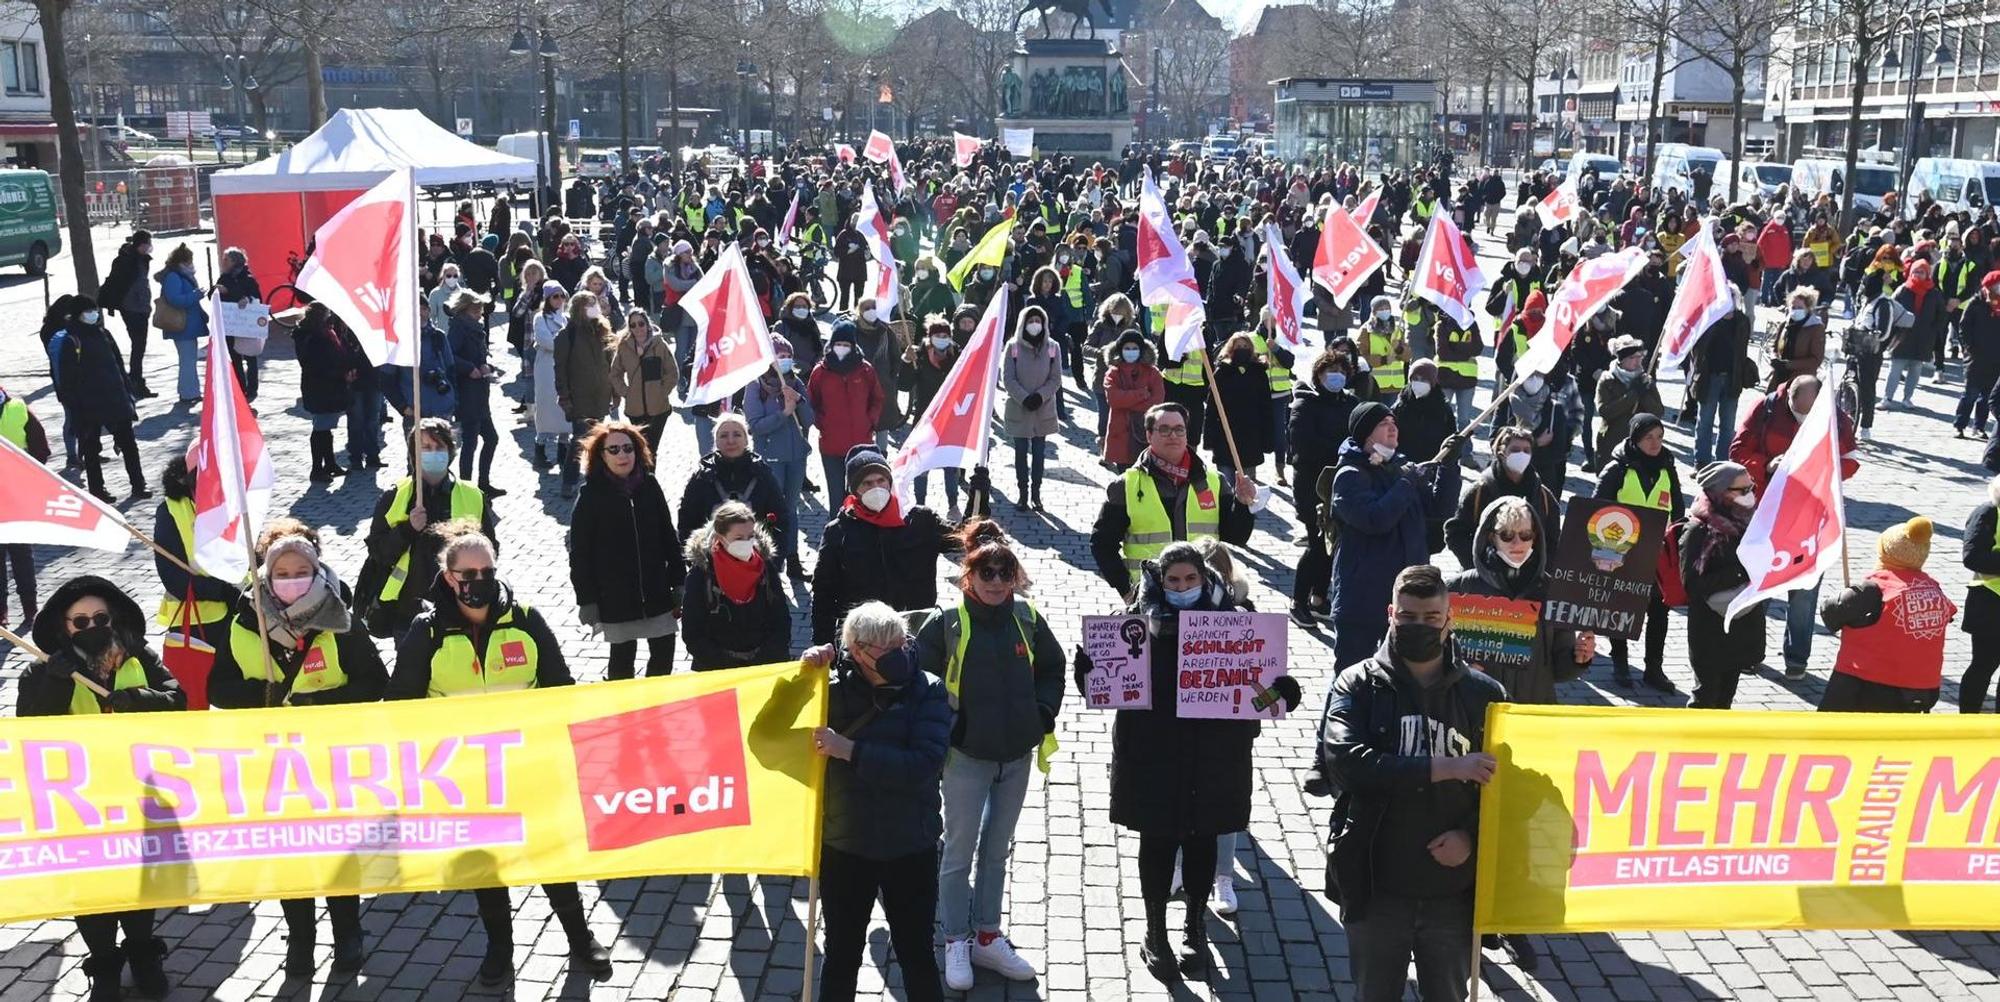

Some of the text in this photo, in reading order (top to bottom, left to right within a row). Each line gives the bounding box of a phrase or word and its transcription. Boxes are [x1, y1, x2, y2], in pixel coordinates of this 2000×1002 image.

[1555, 568, 1652, 597] DIE WELT BRAUCHT
[1588, 588, 1611, 602] DEN
[1188, 616, 1209, 628] WIR
[1545, 600, 1635, 633] FEMINISM
[1183, 628, 1255, 641] GARNICHT SO
[1182, 638, 1265, 656] SCHLECHT
[1478, 638, 1503, 650] sind
[1182, 657, 1232, 669] ARBEITEN
[1259, 657, 1278, 668] WIR
[1090, 677, 1106, 686] YES
[1122, 673, 1137, 682] NO
[1180, 667, 1263, 689] BEZAHLT
[1180, 691, 1229, 704] WERDEN
[593, 775, 736, 817] ver.di
[1573, 750, 1852, 848] MEHR
[1848, 755, 1913, 882] BRAUCHT
[102, 834, 162, 860] UND
[174, 820, 472, 855] ERZIEHUNGSBERUFE
[1615, 853, 1790, 879] ENTLASTUNG
